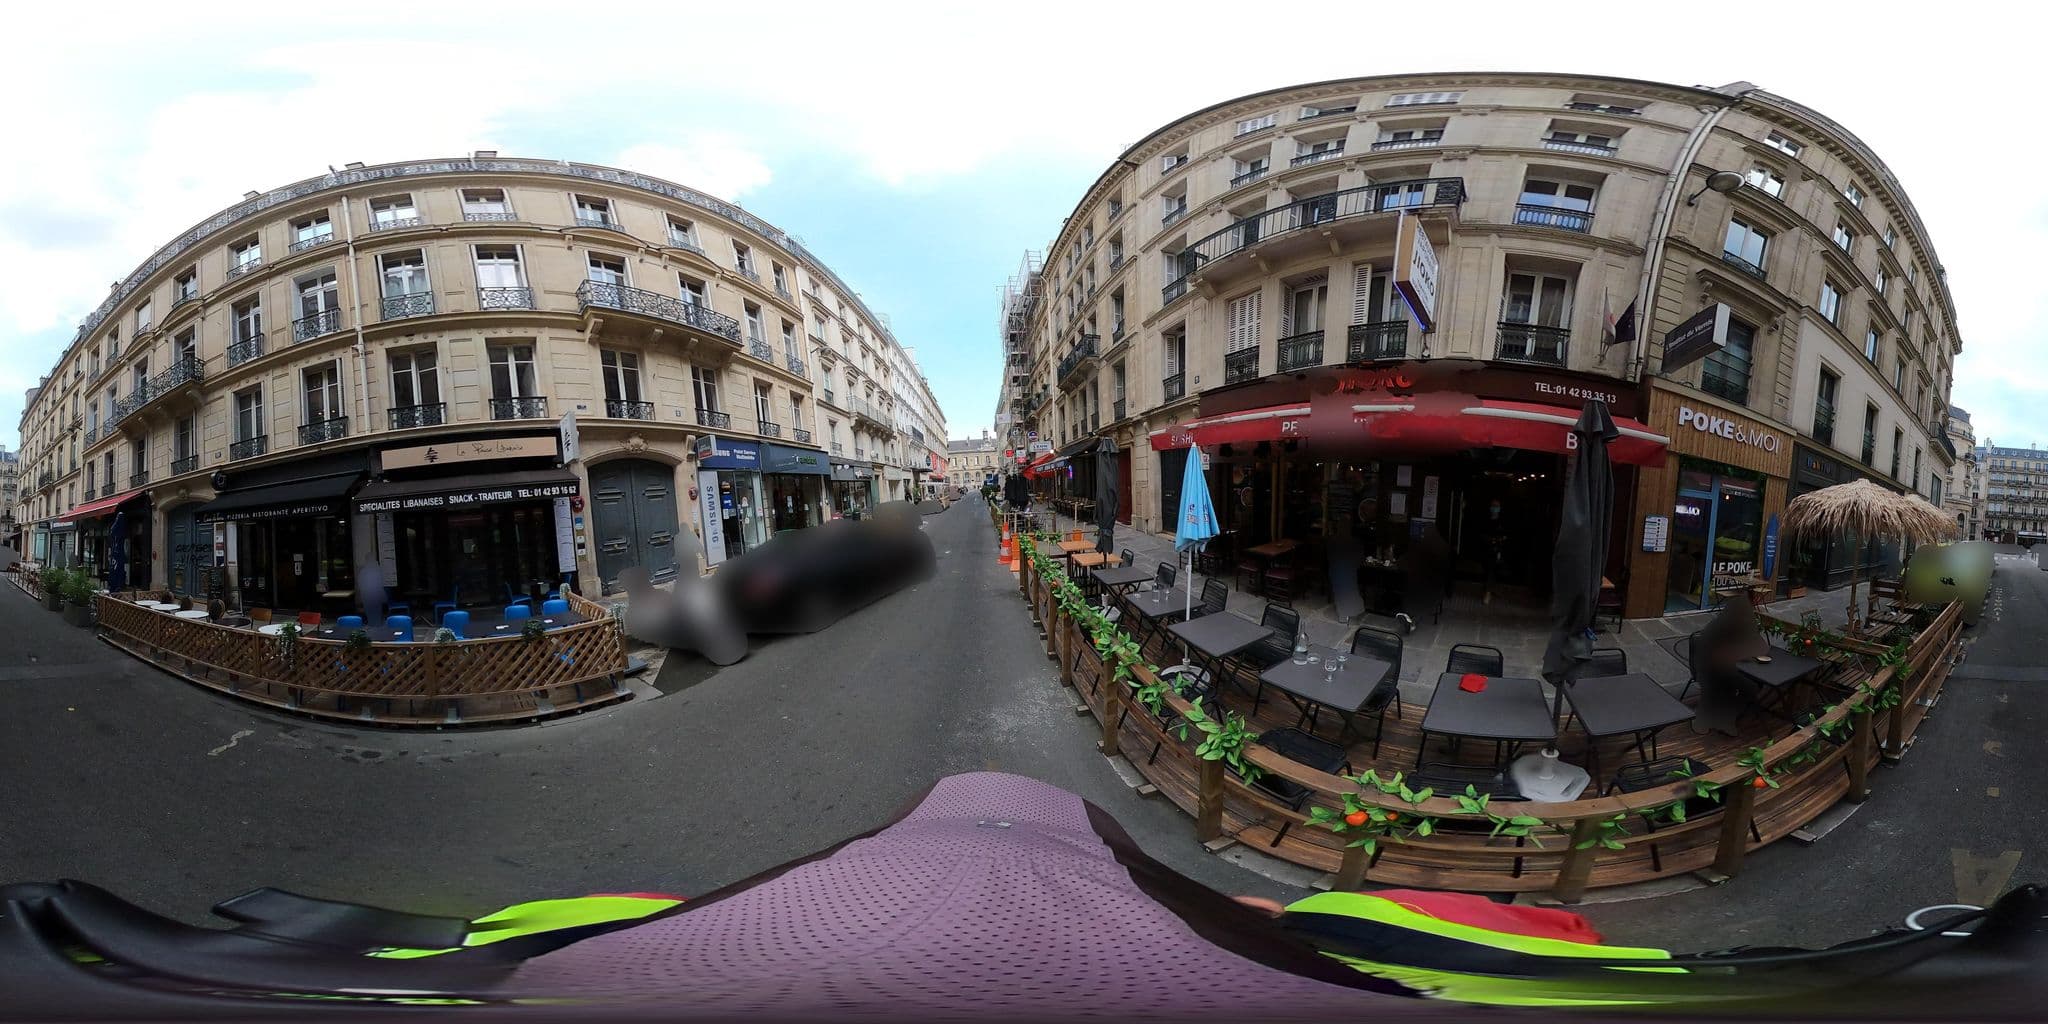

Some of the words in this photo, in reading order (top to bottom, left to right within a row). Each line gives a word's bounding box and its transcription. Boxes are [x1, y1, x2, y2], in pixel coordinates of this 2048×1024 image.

[1569, 388, 1580, 397] 42
[1581, 389, 1592, 399] 93
[1594, 391, 1605, 401] 35
[1606, 394, 1617, 403] 13
[359, 500, 401, 512] SPECIALITES
[403, 497, 444, 508] LIBANAISES
[449, 493, 473, 504] SNACK
[478, 490, 513, 501] TRAITEUR
[518, 488, 533, 498] TEL:
[534, 488, 541, 497] 01
[543, 487, 551, 496] 42
[551, 486, 560, 495] 93
[252, 509, 289, 518] RISTORANTE
[292, 505, 329, 514] APERITIVO
